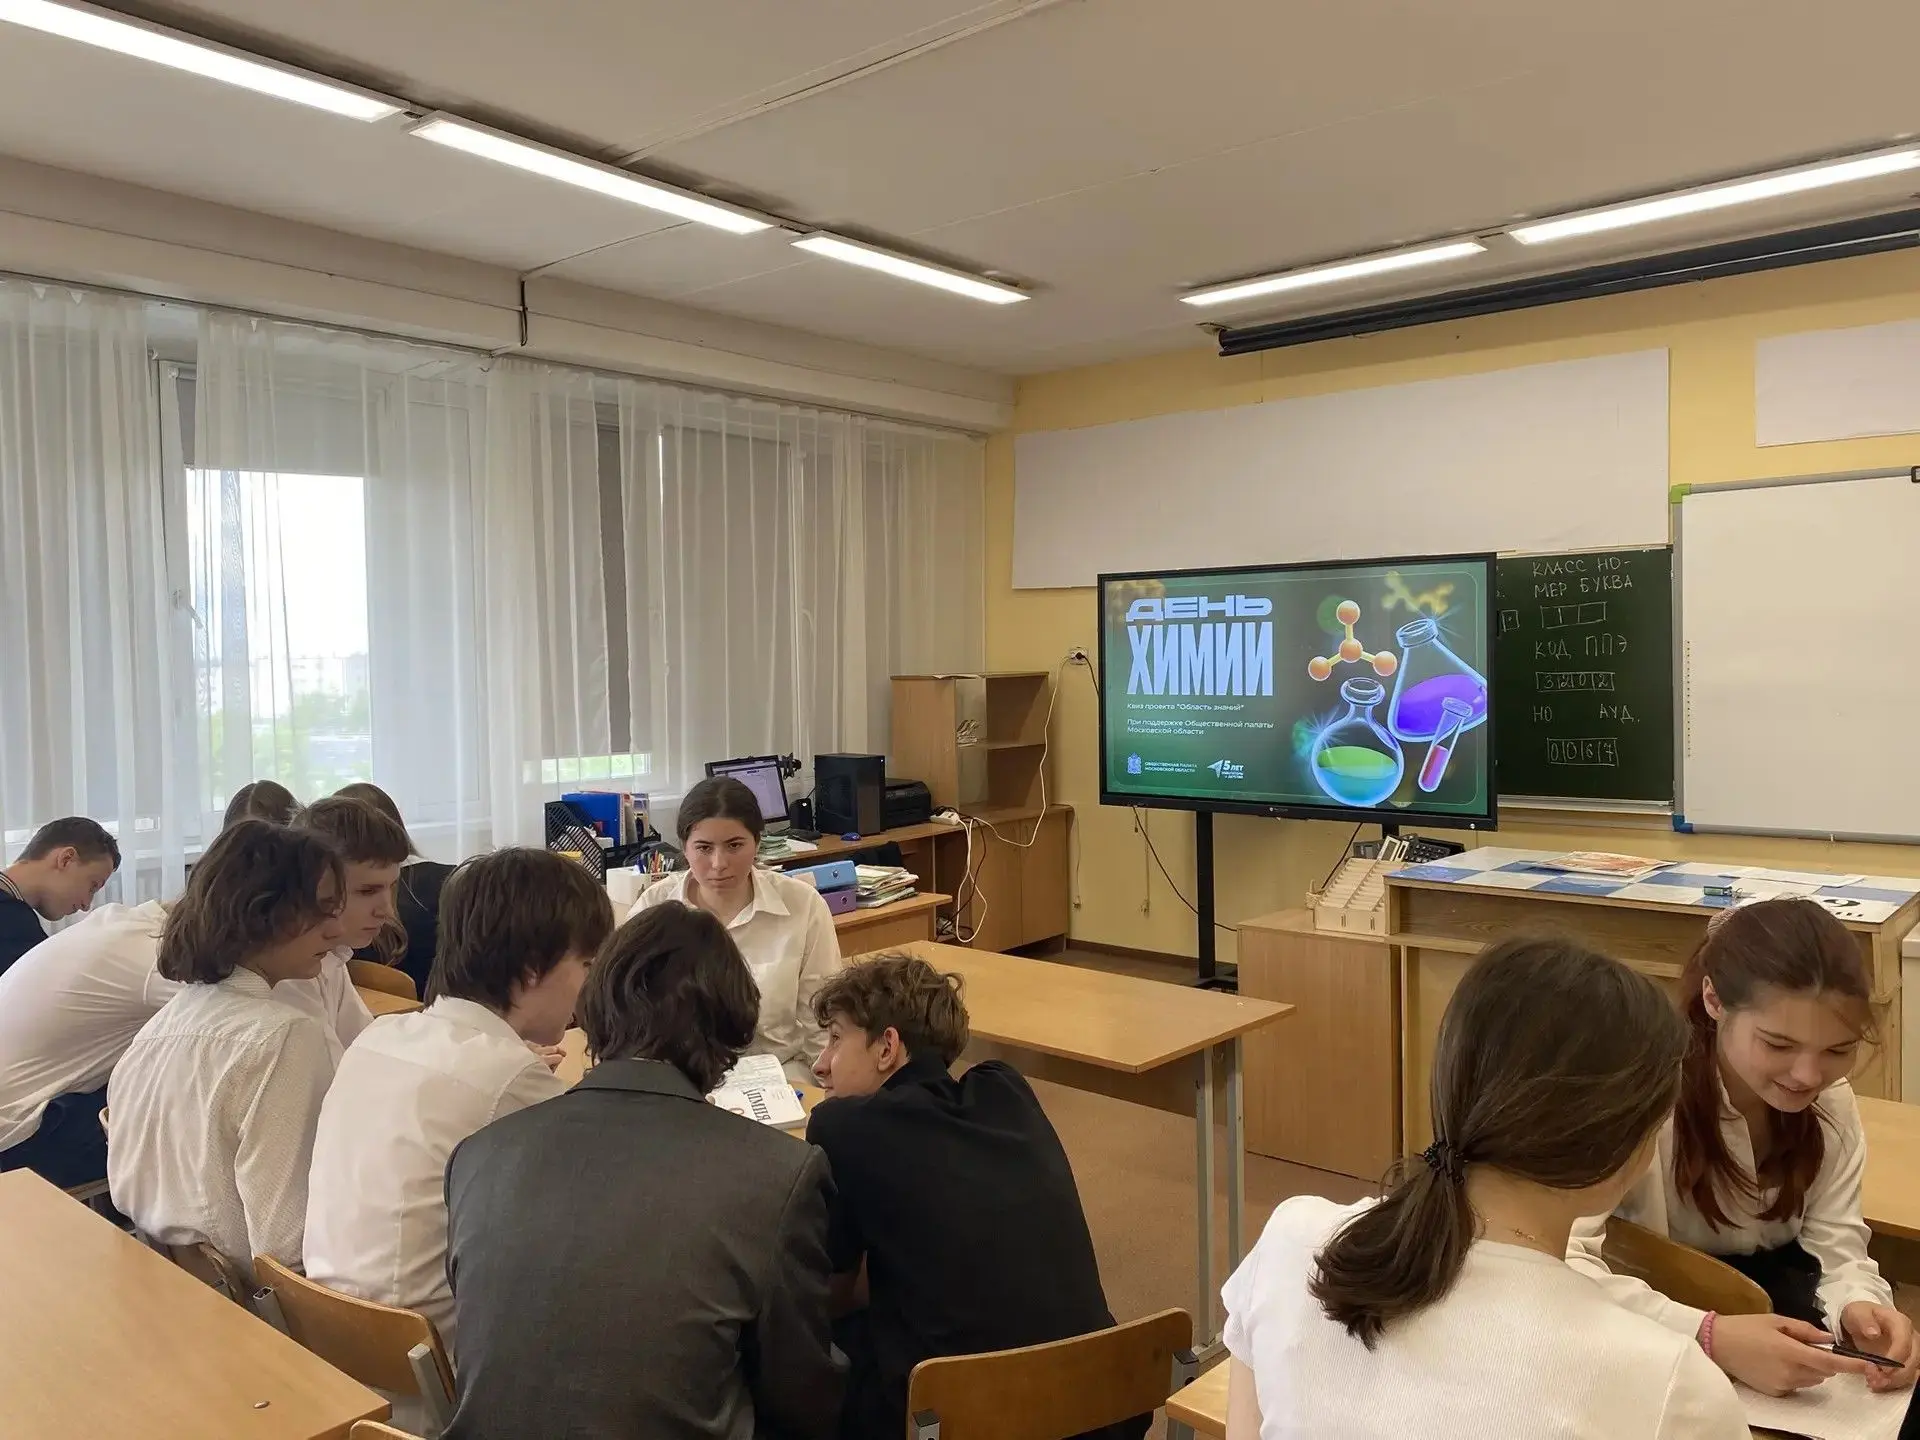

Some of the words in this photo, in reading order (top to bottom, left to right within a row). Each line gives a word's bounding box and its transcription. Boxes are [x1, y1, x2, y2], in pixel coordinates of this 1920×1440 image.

[1532, 559, 1588, 577] КЛАСС
[1534, 582, 1567, 598] МЕР
[1580, 574, 1633, 593] БУКВА
[1126, 594, 1273, 622] ДЕНЬ
[1535, 638, 1571, 660] КОД
[1585, 632, 1627, 656] ППЭ
[1126, 621, 1274, 696] ХИМИИ
[1184, 720, 1243, 728] Общественной
[1533, 705, 1553, 722] НО
[1599, 703, 1640, 724] АУД.
[1223, 760, 1231, 771] 5
